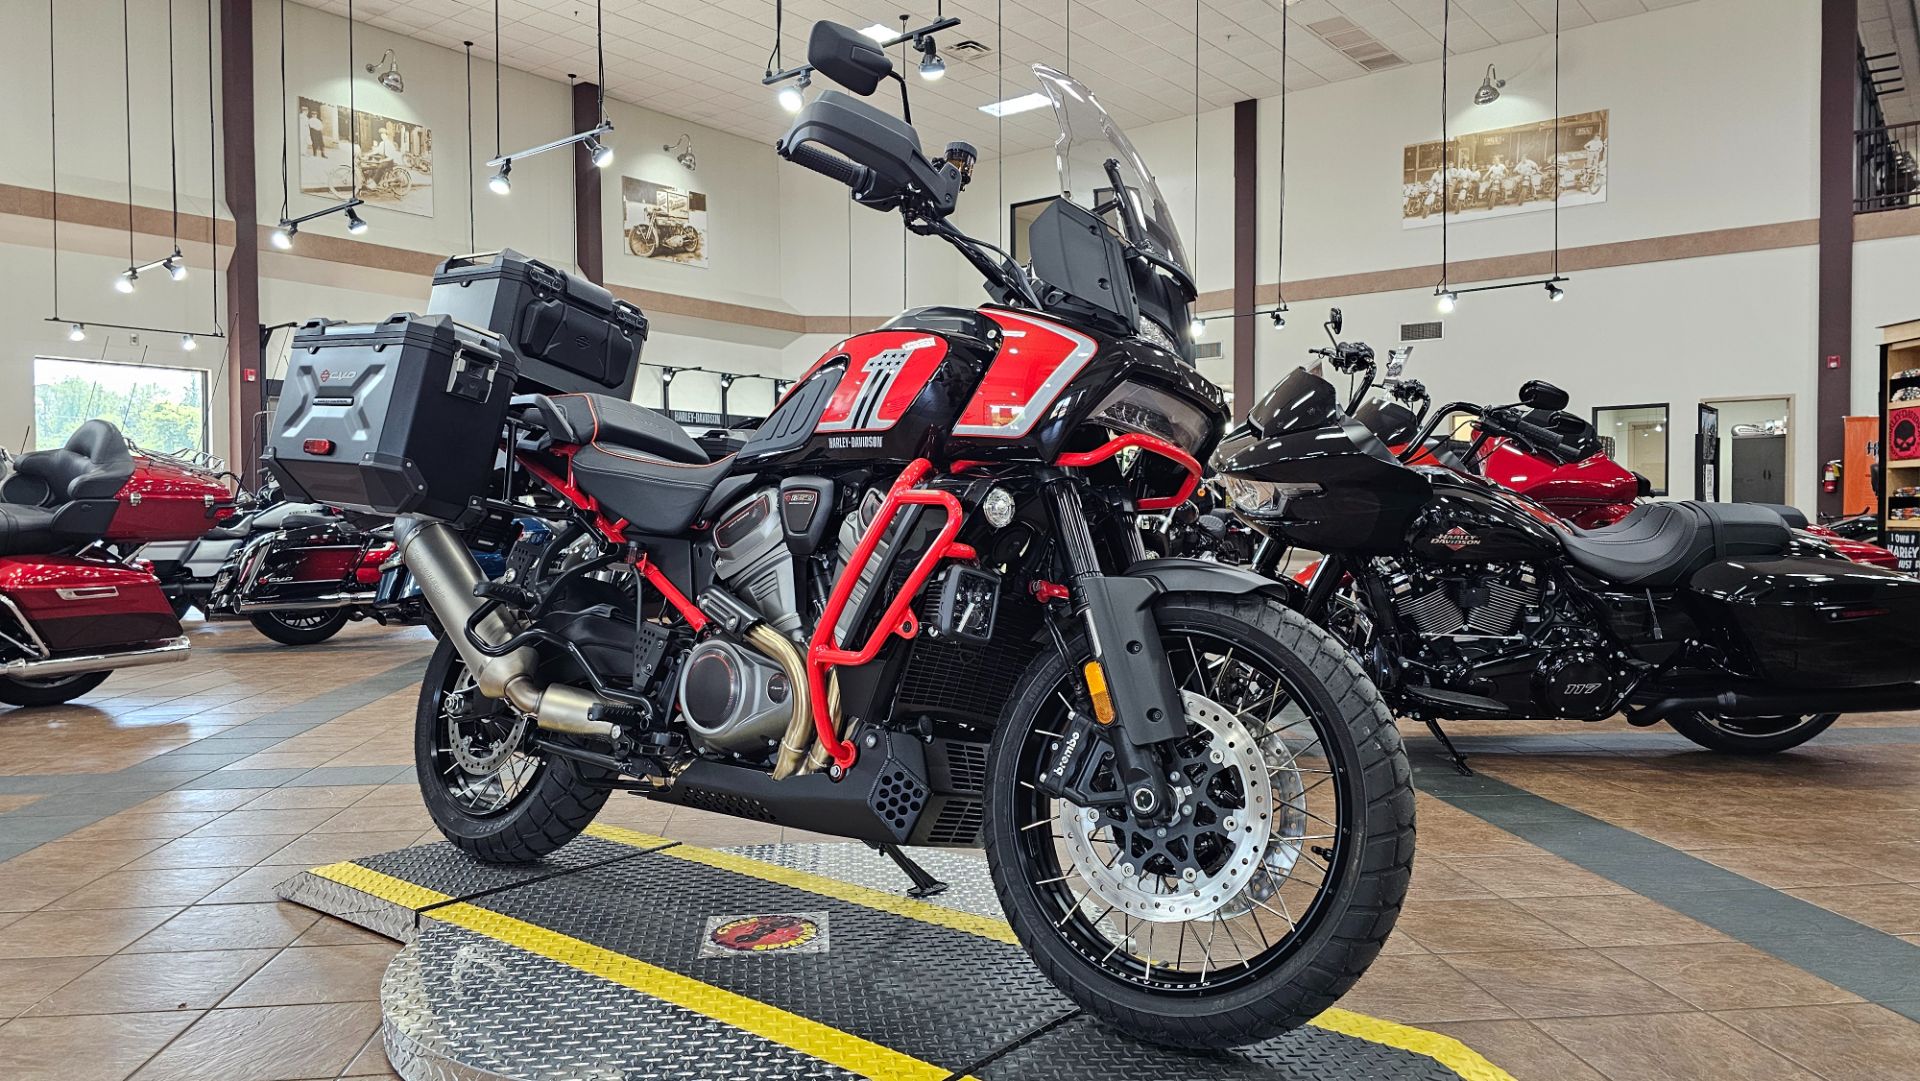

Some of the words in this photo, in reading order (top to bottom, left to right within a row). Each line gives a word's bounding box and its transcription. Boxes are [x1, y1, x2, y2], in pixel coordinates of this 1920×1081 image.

[674, 411, 721, 425] HARLEY-DAVIDSON
[828, 436, 883, 449] HARLEY-DAVIDSON
[1564, 683, 1602, 695] 117
[1053, 731, 1080, 777] brembo
